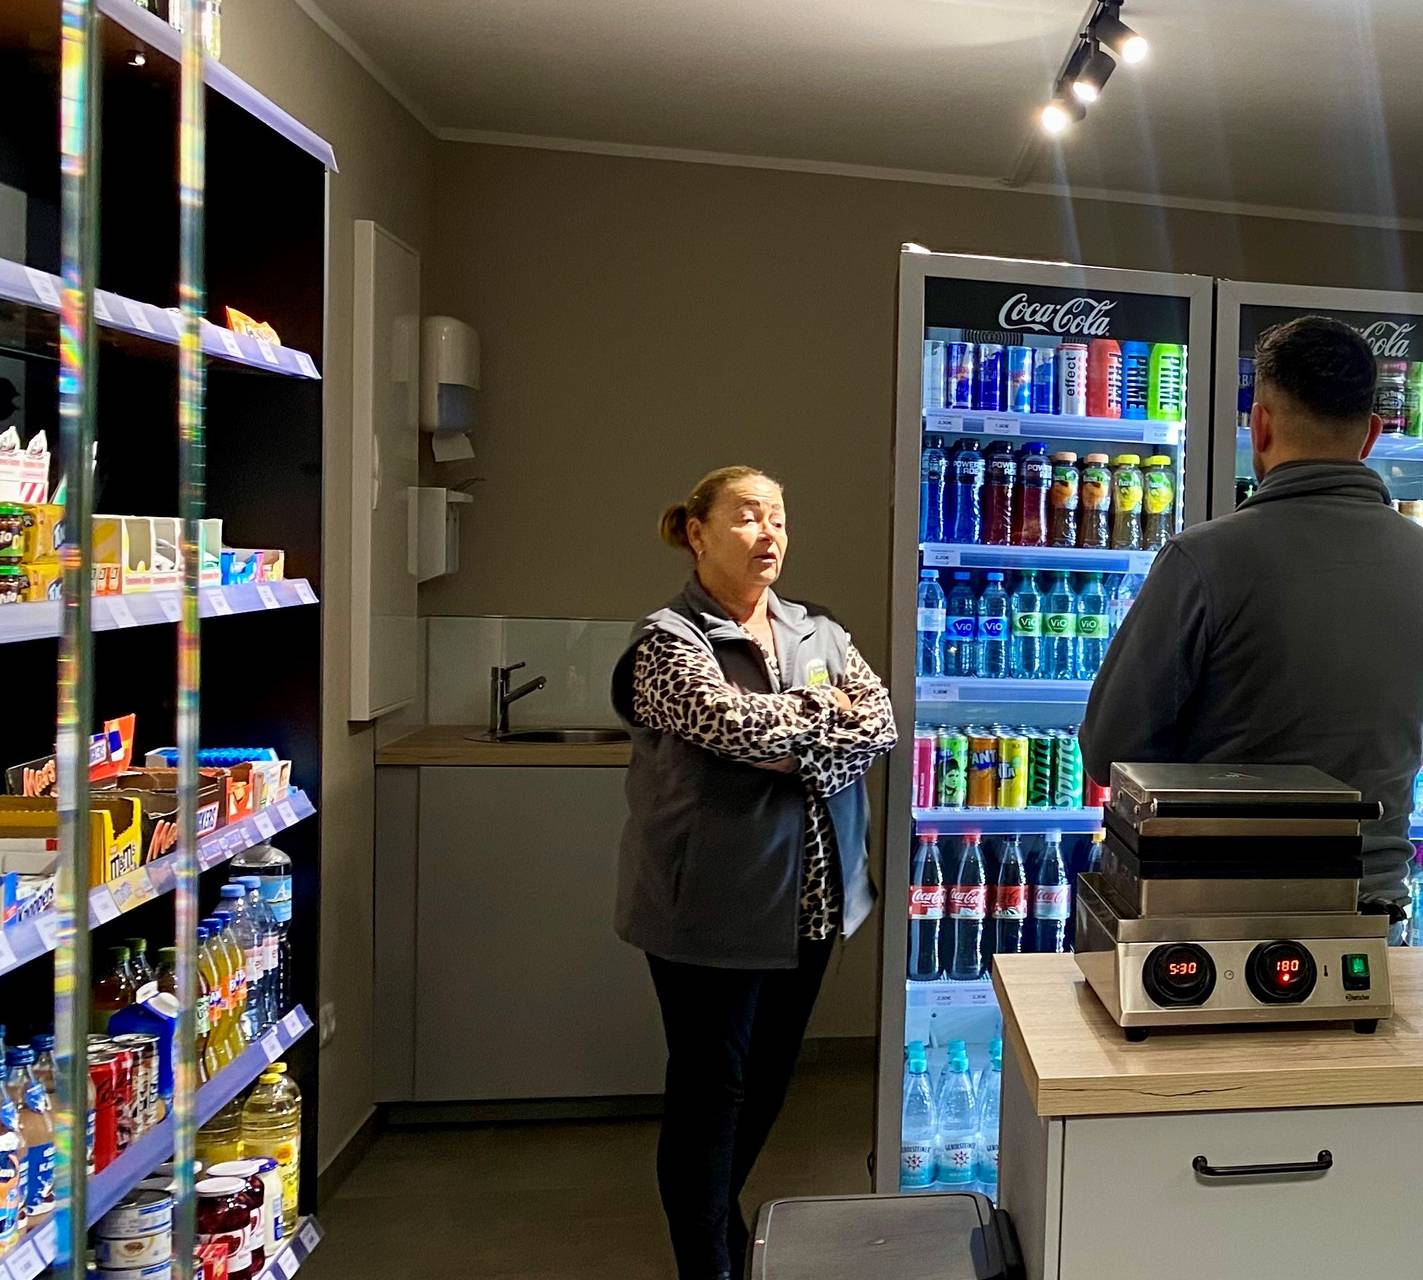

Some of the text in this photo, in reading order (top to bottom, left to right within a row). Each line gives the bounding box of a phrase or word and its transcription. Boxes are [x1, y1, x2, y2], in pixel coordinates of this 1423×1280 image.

[998, 292, 1118, 337] Coca-Cola
[1064, 356, 1077, 397] effect
[1126, 354, 1148, 410] PRIME
[1159, 354, 1182, 410] PRIME
[992, 461, 1017, 469] POWE
[955, 622, 972, 632] ViO
[985, 621, 1003, 631] ViO
[1021, 615, 1036, 626] ViO
[1050, 618, 1068, 628] ViO
[1080, 620, 1097, 629] ViO
[970, 750, 997, 765] ANT
[1054, 738, 1076, 807] Sprite
[1169, 962, 1198, 976] 5:30
[1276, 959, 1300, 972] 180
